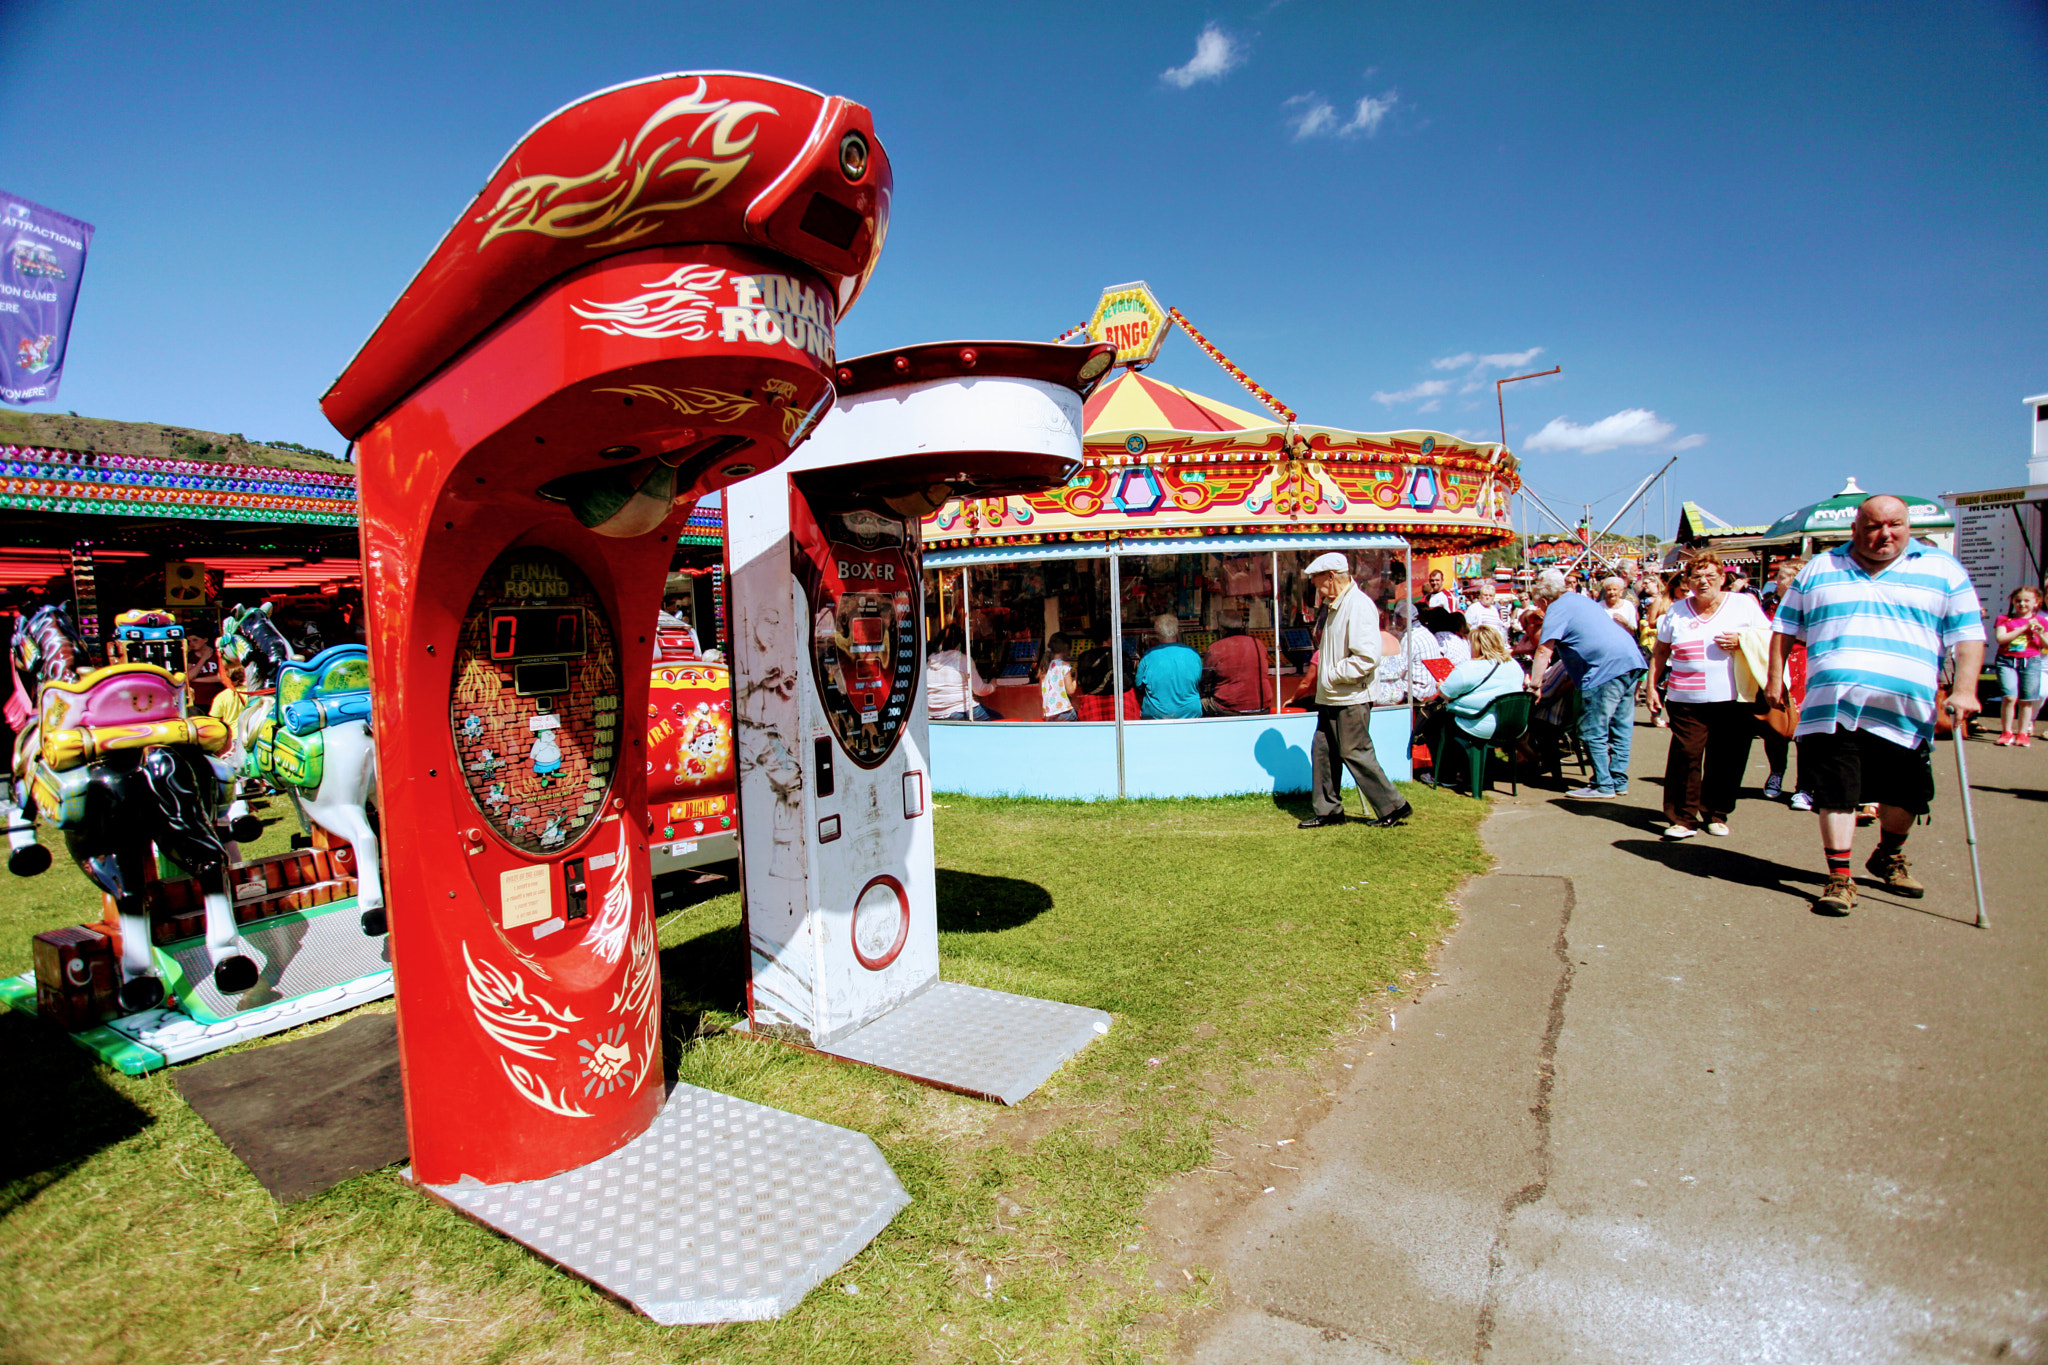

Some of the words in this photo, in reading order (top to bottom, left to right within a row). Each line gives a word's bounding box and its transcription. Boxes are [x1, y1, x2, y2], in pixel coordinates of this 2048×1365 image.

[2, 216, 83, 251] ATTRACTIONS
[23, 290, 58, 302] GAMES
[729, 274, 831, 336] FINAL
[1105, 320, 1149, 350] BINGO
[22, 386, 47, 399] HERE
[761, 376, 798, 400] START
[510, 563, 563, 580] FINAL
[838, 561, 895, 581] BOXER
[505, 581, 569, 597] ROUND
[897, 604, 910, 613] 900
[900, 635, 913, 643] 700
[899, 650, 913, 658] 600
[898, 665, 911, 673] 500
[888, 707, 902, 717] 200
[883, 721, 896, 730] 100
[593, 729, 614, 745] 700
